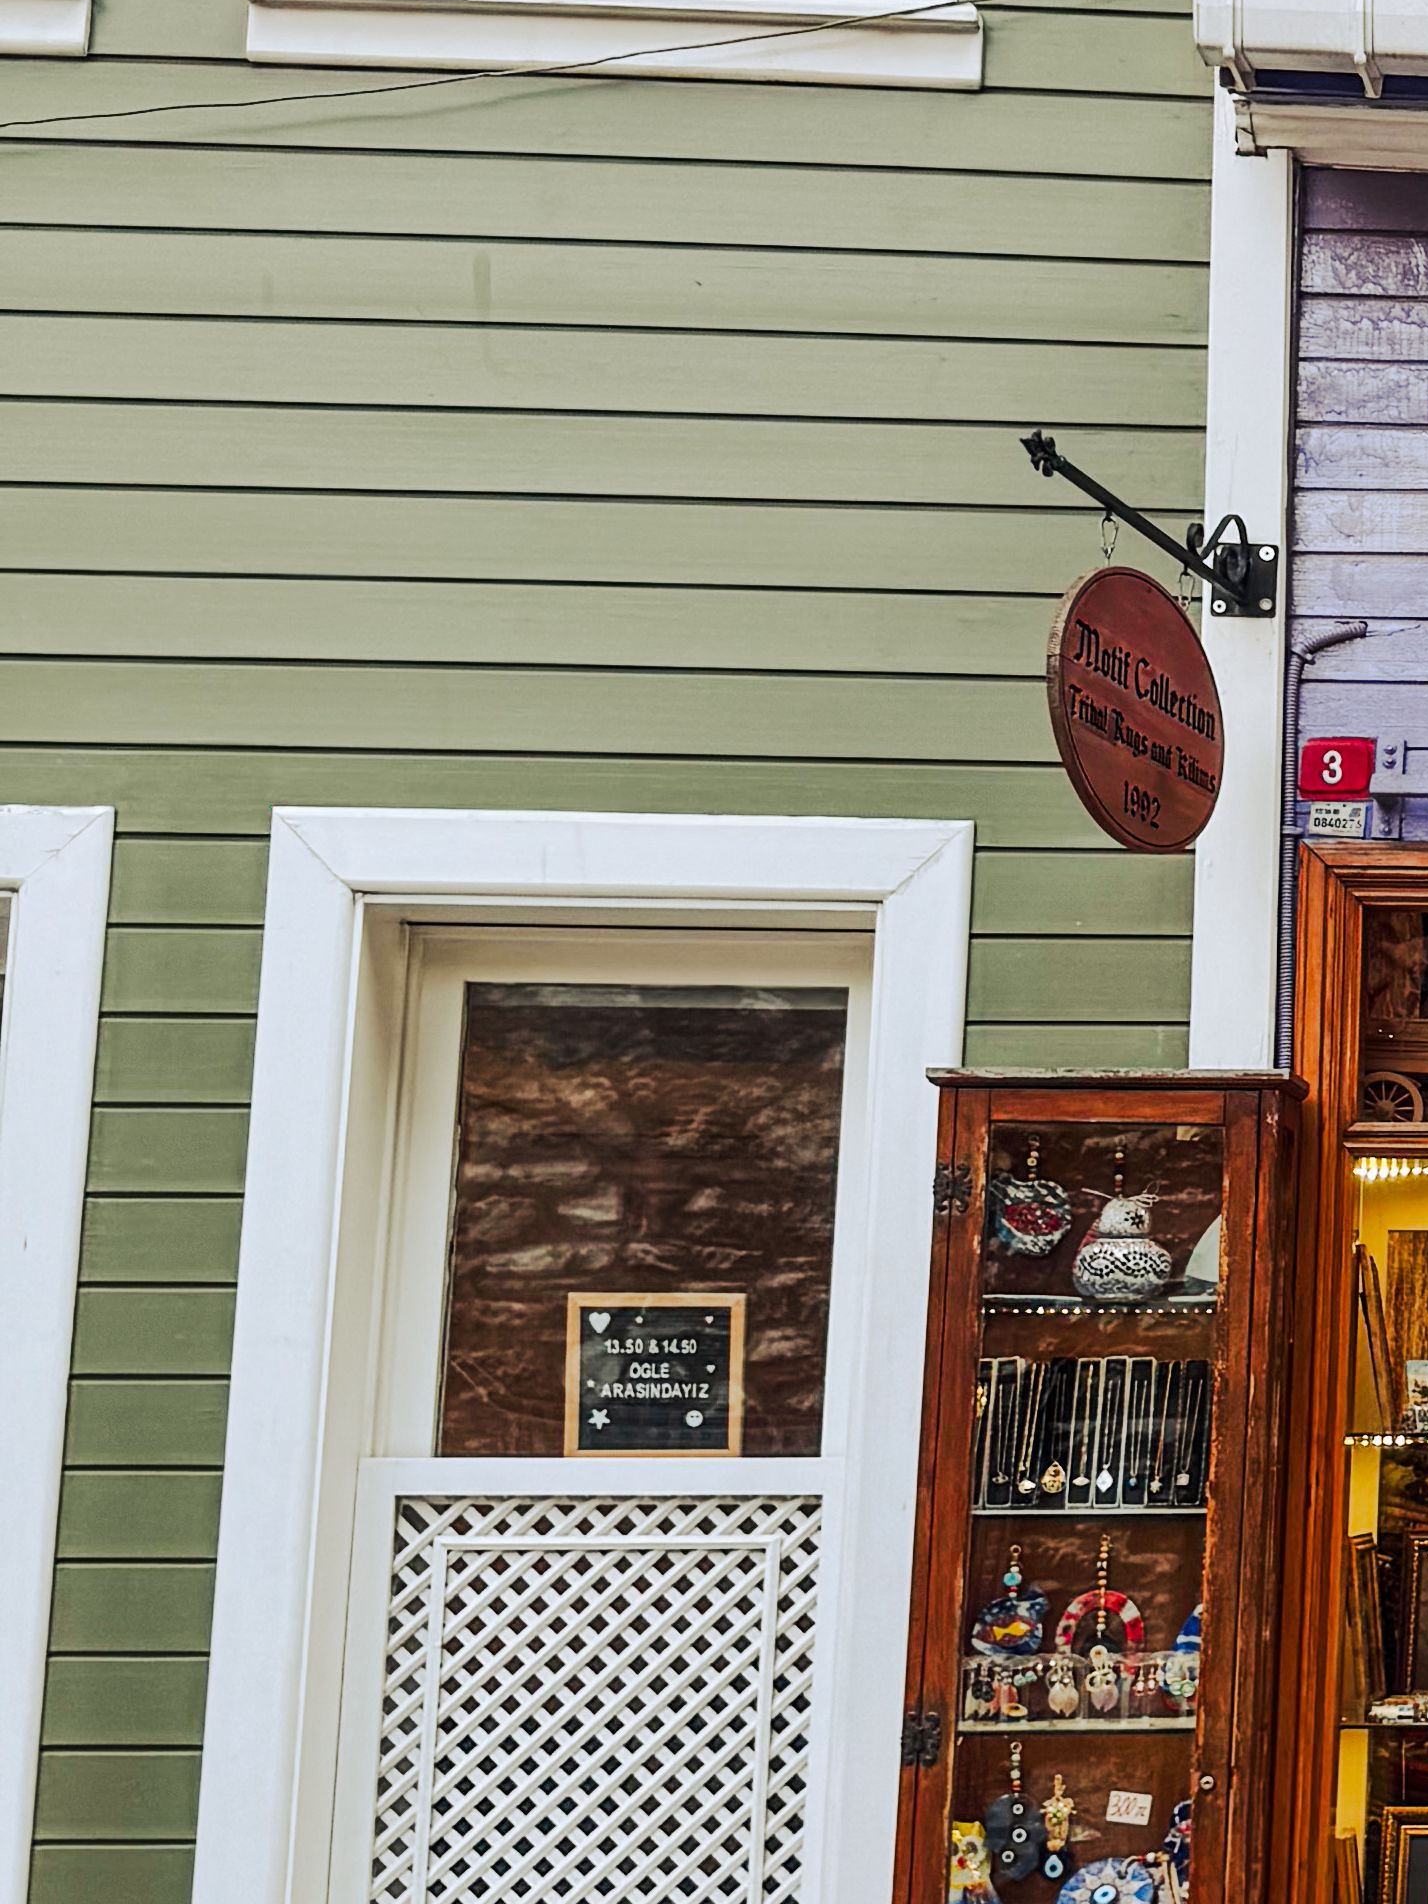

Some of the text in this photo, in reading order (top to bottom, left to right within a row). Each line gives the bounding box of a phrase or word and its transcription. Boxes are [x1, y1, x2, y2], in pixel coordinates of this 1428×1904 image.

[1073, 618, 1216, 741] Motif Collection
[1068, 684, 1108, 734] Tribal
[1111, 708, 1149, 758] Rugs
[1322, 750, 1342, 784] 3
[1123, 780, 1161, 829] 1992
[600, 1383, 710, 1399] ARASINDAYIZ
